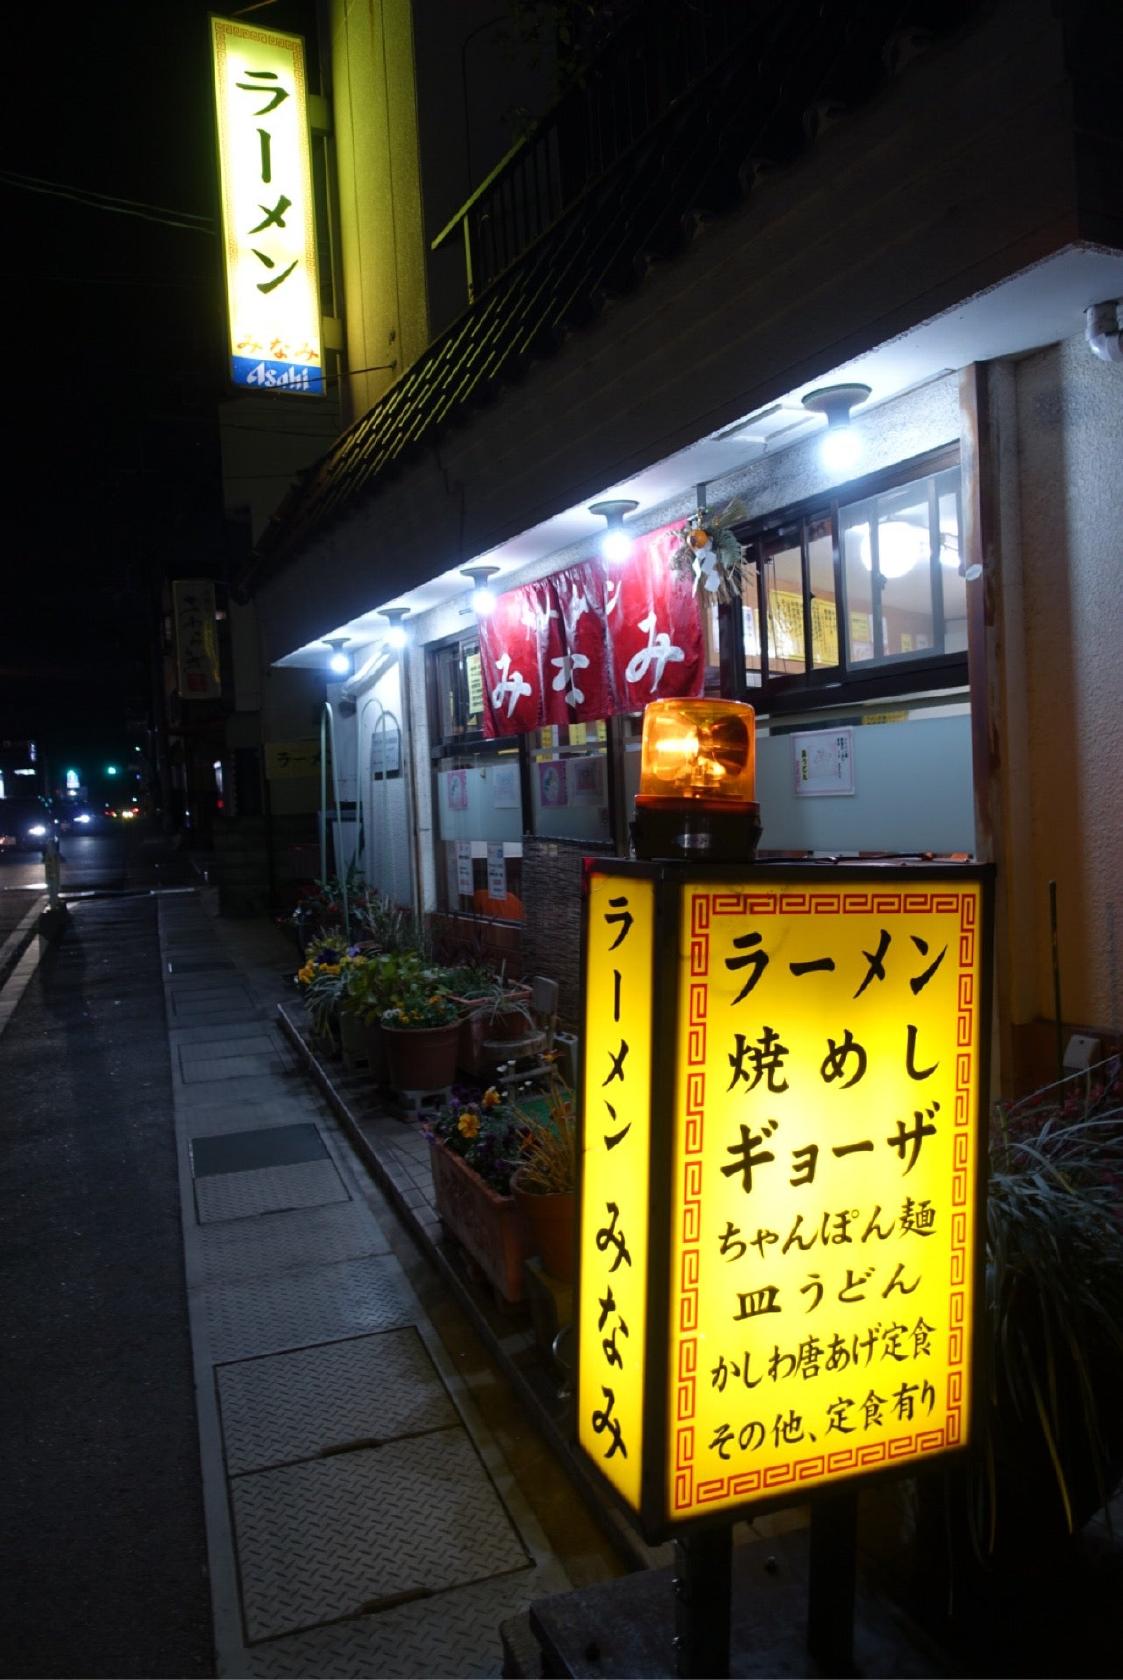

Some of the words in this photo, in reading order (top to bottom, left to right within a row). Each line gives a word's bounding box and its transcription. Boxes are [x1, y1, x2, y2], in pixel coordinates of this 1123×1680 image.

[235, 70, 298, 294] ラーメン
[246, 361, 309, 390] Asahi
[724, 928, 948, 1006] ラーメン
[602, 896, 634, 1151] ラーメン
[726, 1024, 940, 1094] 焼めし
[720, 1101, 941, 1194] ギョーザ
[717, 1197, 937, 1263] ちゃんぽん麺
[591, 1202, 632, 1460] みなみ
[732, 1263, 921, 1321] 皿うどん
[711, 1316, 937, 1393] かしわ唐あげ定食
[708, 1379, 936, 1461] その他、定食有り
